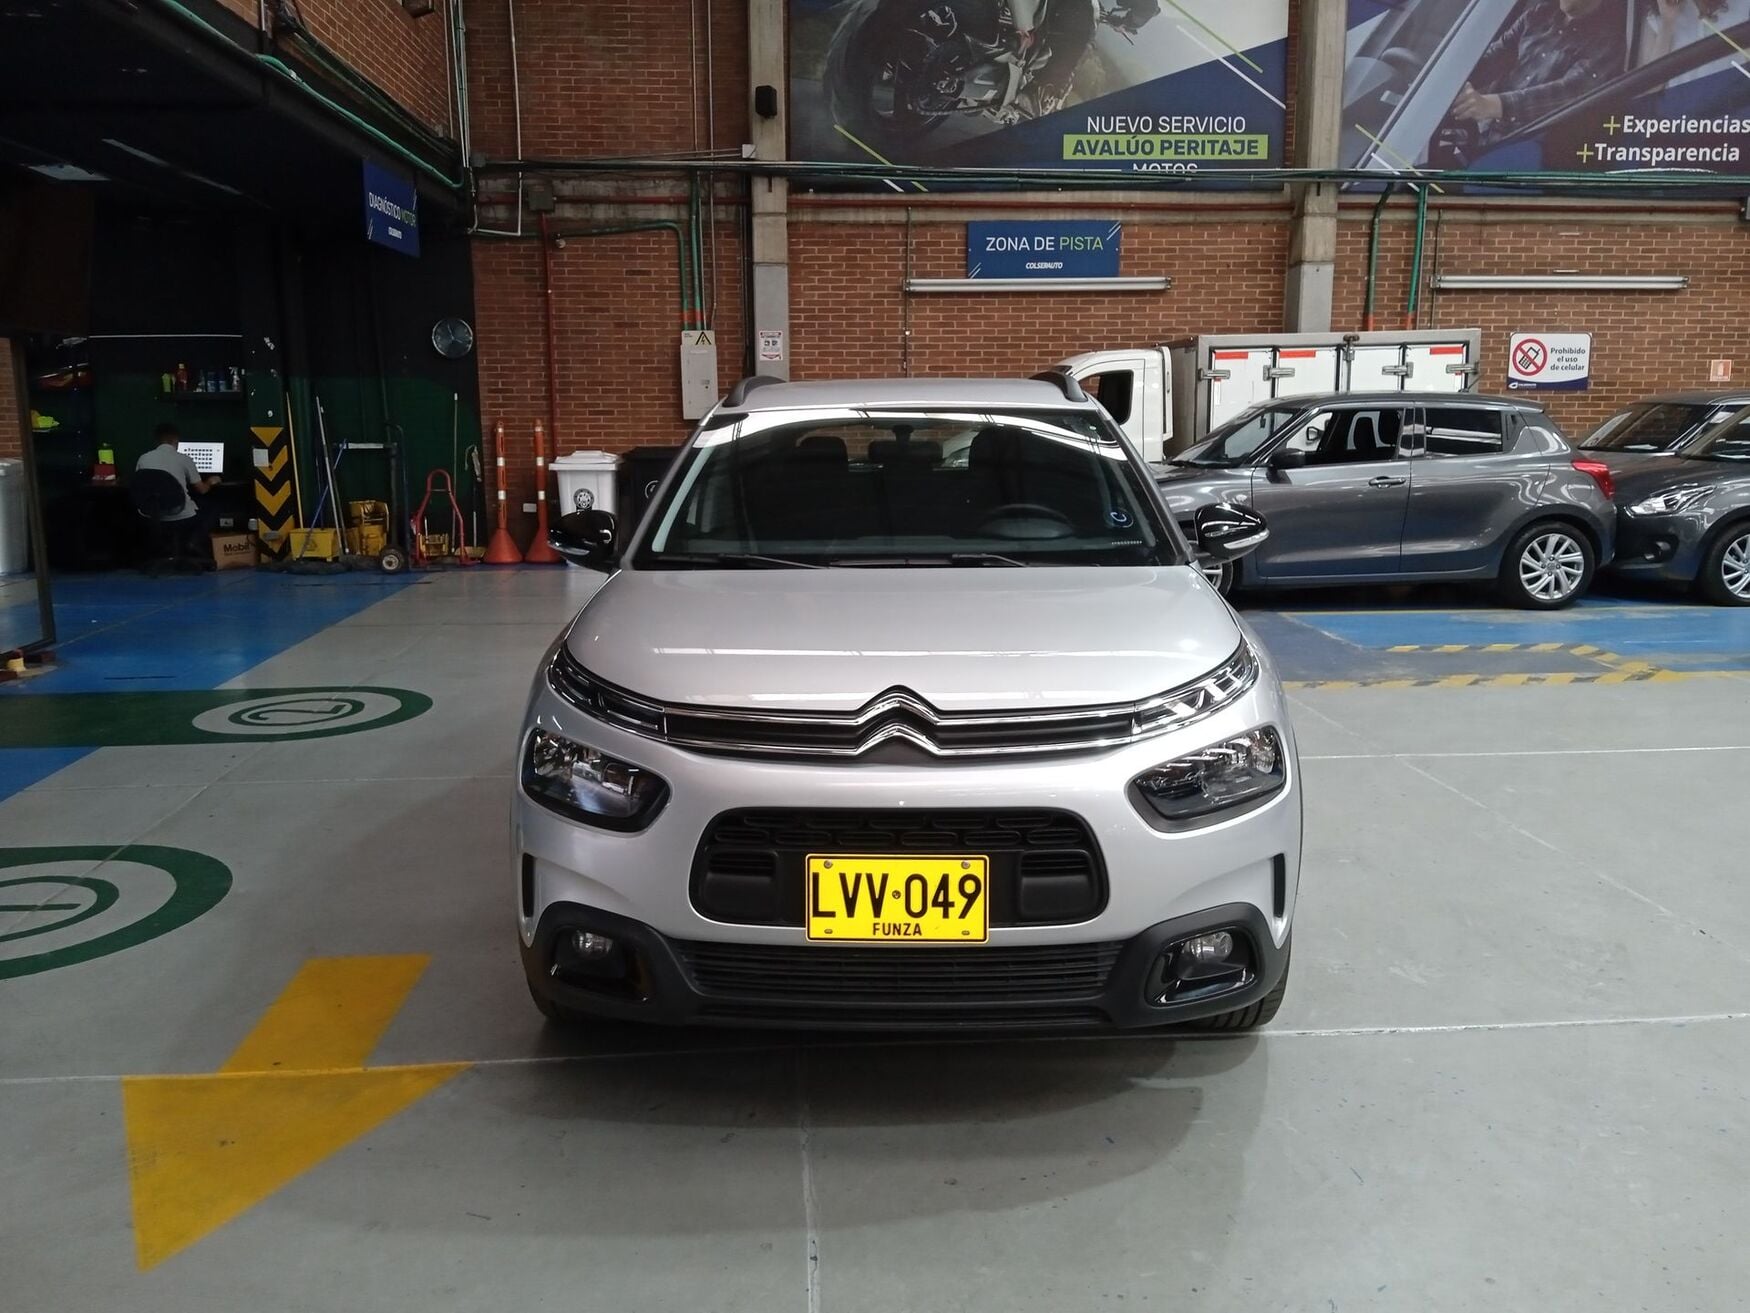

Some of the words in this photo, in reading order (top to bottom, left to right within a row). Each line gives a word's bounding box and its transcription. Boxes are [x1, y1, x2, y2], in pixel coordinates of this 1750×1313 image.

[1087, 116, 1153, 134] NUEVO
[1158, 116, 1246, 134] SERVICIO
[1072, 136, 1154, 156] AVALÚO
[1160, 139, 1259, 156] PERITAJE
[986, 237, 1030, 251] ZONA
[1034, 237, 1055, 251] DE
[1059, 237, 1103, 251] PISTA
[1550, 347, 1586, 355] Prohibido
[873, 922, 922, 936] FUNZA
